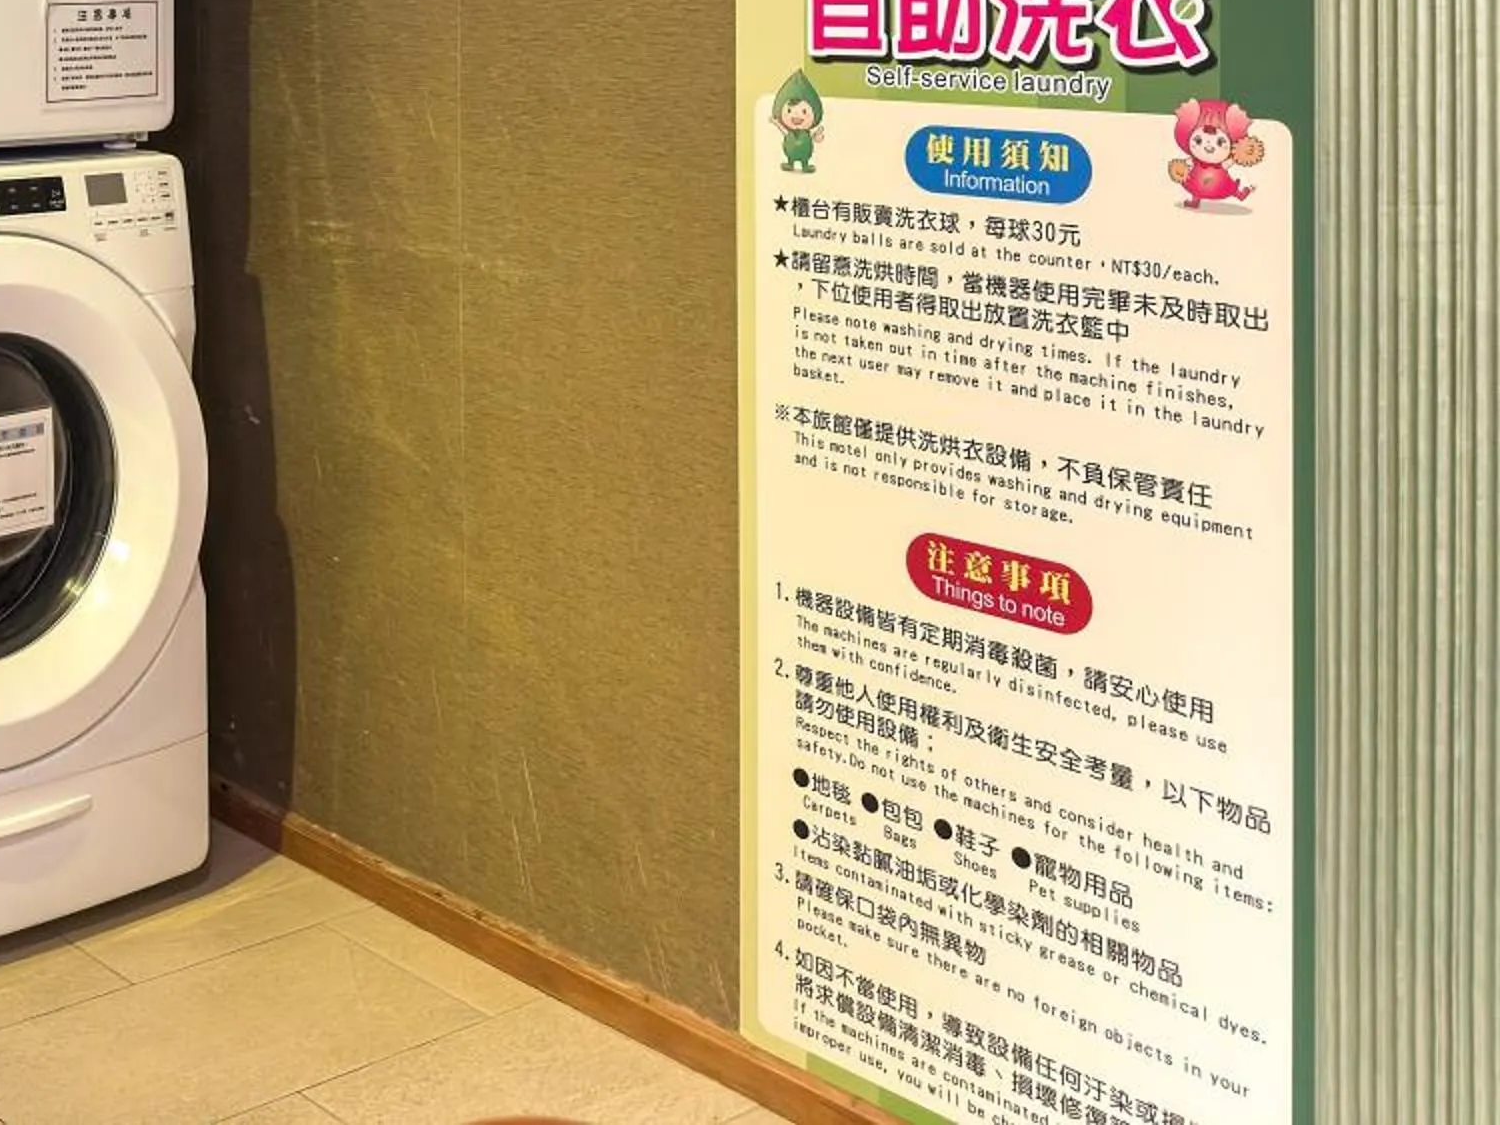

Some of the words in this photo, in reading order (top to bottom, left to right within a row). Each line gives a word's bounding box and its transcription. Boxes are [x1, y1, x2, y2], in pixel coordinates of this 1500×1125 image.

[866, 65, 1008, 93] Self-service
[1012, 68, 1112, 101] laundry
[926, 133, 1071, 172] 使用須知
[943, 168, 1051, 196] Information
[792, 223, 847, 244] Laundry
[852, 230, 893, 248] balls
[899, 238, 925, 252] are
[929, 240, 965, 256] sold
[971, 245, 987, 259] at
[996, 246, 1021, 263] the
[793, 305, 840, 327] Please
[845, 316, 877, 332] note
[883, 322, 941, 344] washing
[947, 331, 973, 346] and
[979, 334, 1034, 358] drying
[1040, 343, 1093, 364] times.
[1131, 358, 1160, 375] the
[1171, 362, 1241, 390] laundry
[795, 324, 809, 340] is
[813, 331, 837, 345] not
[844, 334, 883, 352] taken
[889, 343, 913, 357] out
[921, 344, 937, 361] in
[943, 348, 977, 368] time
[983, 356, 1027, 376] after
[1035, 364, 1063, 382] the
[1069, 372, 1138, 394] machine
[1146, 380, 1234, 411] finishes,
[793, 362, 845, 385] basket.
[794, 345, 817, 361] the
[821, 352, 853, 367] next
[859, 358, 890, 373] user
[896, 364, 922, 380] may
[929, 370, 980, 389] remove
[988, 375, 1003, 392] it
[1010, 384, 1038, 399] and
[1043, 388, 1091, 408] place
[1101, 394, 1117, 412] it
[1127, 398, 1145, 418] in
[1154, 405, 1183, 424] the
[1193, 410, 1265, 439] laundry
[793, 430, 825, 450] This
[829, 442, 867, 459] motel
[875, 450, 908, 469] only
[912, 458, 982, 484] provides
[987, 474, 1053, 500] washing
[1059, 489, 1088, 506] and
[1093, 494, 1153, 522] drying
[1161, 510, 1253, 540] equipment
[794, 453, 818, 468] and
[824, 456, 838, 472] is
[843, 464, 867, 478] not
[873, 470, 965, 500] responsible
[972, 488, 996, 507] for
[1003, 498, 1073, 524] storage.
[775, 581, 790, 602] 1.
[926, 540, 1072, 605] 注意事項
[932, 575, 994, 613] Things
[998, 591, 1017, 613] to
[1021, 599, 1066, 627] note
[773, 656, 790, 680] 2.
[795, 614, 819, 634] The
[823, 626, 887, 654] machines
[893, 646, 918, 663] are
[924, 655, 1001, 688] regularly
[1008, 676, 1117, 723] disinfected,
[1127, 714, 1189, 742] please
[1195, 735, 1227, 754] use
[797, 635, 827, 655] them
[831, 646, 864, 666] with
[869, 658, 957, 694] confidence.
[795, 715, 849, 746] Respect
[856, 738, 879, 756] the
[885, 747, 935, 774] rights
[941, 768, 957, 782] of
[963, 775, 1017, 803] others
[1023, 796, 1052, 815] and
[1058, 808, 1133, 842] consider
[1143, 832, 1203, 866] health
[1211, 860, 1244, 880] and
[803, 794, 857, 826] Carpets
[811, 772, 853, 807] 地毯
[881, 797, 924, 832] 包包
[883, 824, 917, 850] Bags
[871, 763, 895, 781] not
[901, 774, 927, 792] use
[933, 784, 959, 803] the
[963, 796, 1036, 830] machines
[1044, 820, 1068, 841] for
[1078, 834, 1106, 855] the
[1114, 844, 1204, 892] following
[1214, 877, 1273, 913] items:
[955, 823, 1001, 858] 鞋子
[774, 861, 790, 884] 3.
[953, 850, 997, 880] Shoes
[1033, 852, 1133, 910] 寵物用品
[1029, 878, 1056, 902] Pet
[1063, 895, 1141, 934] supplies
[793, 845, 830, 870] Items
[835, 864, 933, 912] contaminated
[937, 904, 973, 928] with
[979, 921, 1033, 952] sticky
[1039, 945, 1095, 977] grease
[1103, 970, 1120, 986] or
[1129, 980, 1207, 1022] chemical
[1218, 1014, 1267, 1045] dyes.
[797, 917, 848, 948] pocket.
[797, 895, 843, 926] Please
[848, 920, 881, 942] make
[886, 936, 920, 959] sure
[927, 951, 969, 979] there
[974, 974, 1001, 993] are
[1007, 987, 1025, 1004] no
[1033, 995, 1097, 1034] foreign
[1104, 1028, 1173, 1066] objects
[1184, 1056, 1202, 1078] in
[1210, 1073, 1249, 1098] your
